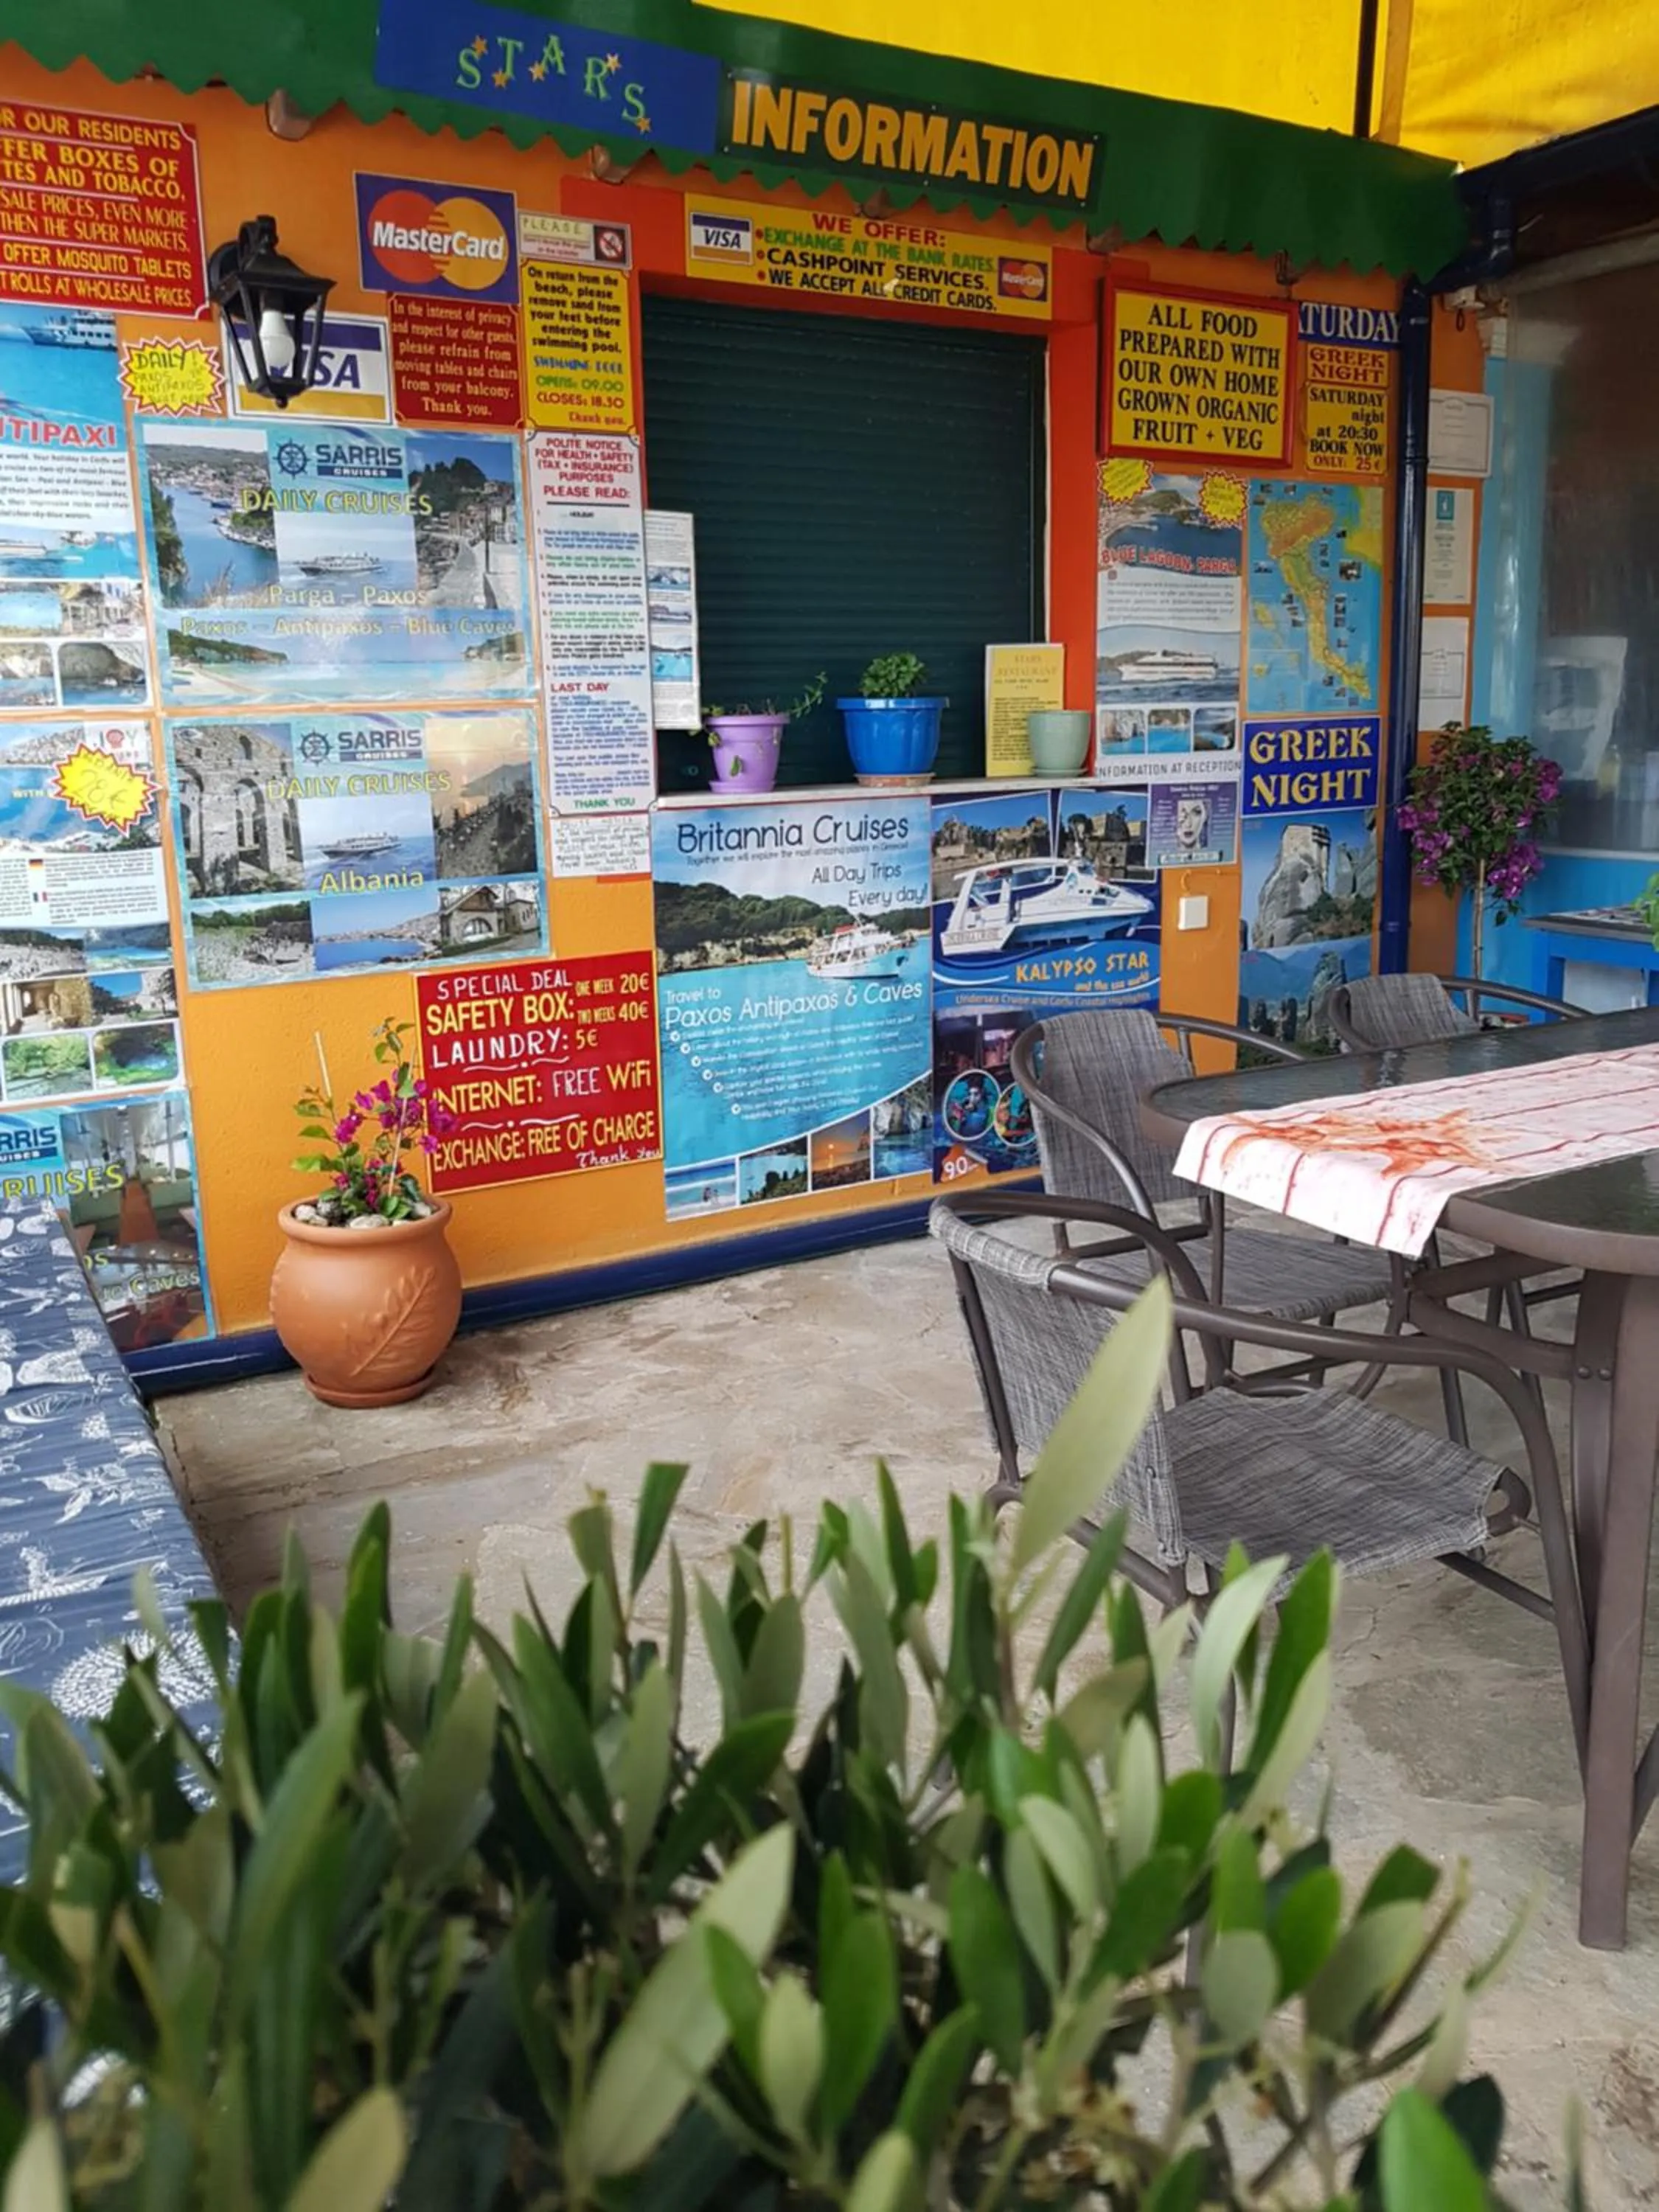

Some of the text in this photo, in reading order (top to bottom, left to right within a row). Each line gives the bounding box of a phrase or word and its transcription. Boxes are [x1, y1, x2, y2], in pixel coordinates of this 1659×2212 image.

[456, 34, 647, 122] STARS
[24, 112, 181, 150] OUR RESIDENTS
[732, 80, 1093, 199] INFORMATION
[59, 146, 179, 177] BOXES OF
[44, 166, 185, 201] AND TOBACCO,
[42, 195, 100, 220] PRICES,
[103, 202, 142, 223] EVEN
[146, 206, 187, 230] MORE
[44, 217, 69, 237] THE
[74, 220, 119, 243] SUPER
[124, 226, 190, 252] MARKETS.
[373, 222, 504, 260] MasterCard
[703, 229, 742, 248] VISA
[813, 213, 946, 247] WE OFFER:
[3, 243, 192, 279] OFFER MOSQUITO TABLETS
[768, 248, 989, 291] CASHPOINT SERVICES.
[11, 273, 51, 295] ROLLS
[56, 277, 71, 295] AT
[74, 280, 150, 305] WHOLESALE
[528, 267, 619, 287] On return from the
[535, 281, 613, 300] beach, please
[769, 271, 997, 310] WE ACCEPT ALL CREDIT CARDS.
[1147, 304, 1257, 338] ALL FOOD
[400, 341, 511, 361] please refrain from
[592, 340, 622, 354] pool.
[1120, 329, 1280, 369] PREPARED WITH
[1310, 347, 1385, 367] GREEK
[136, 351, 187, 371] DAILY
[1312, 364, 1385, 383] NIGHT
[402, 376, 514, 400] from your balcony.
[1119, 358, 1279, 397] OUR OWN HOME
[422, 397, 492, 417] Thank you.
[537, 392, 588, 406] CLOSES:
[1118, 388, 1279, 425] GROWN ORGANIC
[1310, 387, 1384, 406] SATURDAY
[1352, 408, 1385, 426] night
[546, 438, 622, 451] POLITE NOTICE
[1133, 418, 1263, 451] FRUIT + VEG
[1317, 425, 1378, 440] at 20:30
[316, 444, 403, 467] SARRIS
[535, 448, 633, 462] FOR HEALTH SAFETY
[1310, 439, 1382, 456] BOOK NOW
[559, 472, 613, 483] PURPOSES
[571, 462, 633, 473] INSURANCE)
[241, 489, 433, 516] DAILY CRUISES
[543, 485, 630, 498] PLEASE READ:
[269, 585, 428, 608] Parga Paxos
[181, 616, 515, 636] Paxos Antipaxos Blue Caves
[551, 682, 610, 693] LAST DAY
[338, 730, 422, 748] SARRIS
[1249, 726, 1372, 765] GREEK
[1171, 763, 1182, 773] AT
[1185, 761, 1241, 773] RECEPTION
[265, 771, 452, 799] DAILY CRUISES
[1251, 768, 1371, 807] NIGHT
[574, 797, 636, 809] THANK YOU
[677, 819, 803, 853] Britannia
[813, 815, 908, 844] Cruises
[320, 868, 423, 894] Albania
[812, 862, 902, 884] All Day Trips
[849, 883, 928, 906] Every day!
[1016, 951, 1149, 983] KALYPSO STAR
[438, 970, 649, 1000] SPECIAL DEAL 20€
[666, 987, 721, 1004] Travel to
[426, 992, 649, 1035] SAFETY BOX: 40€
[665, 1006, 731, 1029] Paxos
[739, 991, 838, 1020] Antipaxos
[863, 981, 922, 1004] Caves
[433, 1027, 599, 1068] LAUNDRY: 5€
[552, 1067, 601, 1098] FREE
[528, 1124, 560, 1157] FREE
[566, 1121, 588, 1149] OF
[593, 1110, 654, 1145] CHARGE
[576, 1145, 630, 1168] Thank
[944, 1155, 967, 1180] 90
